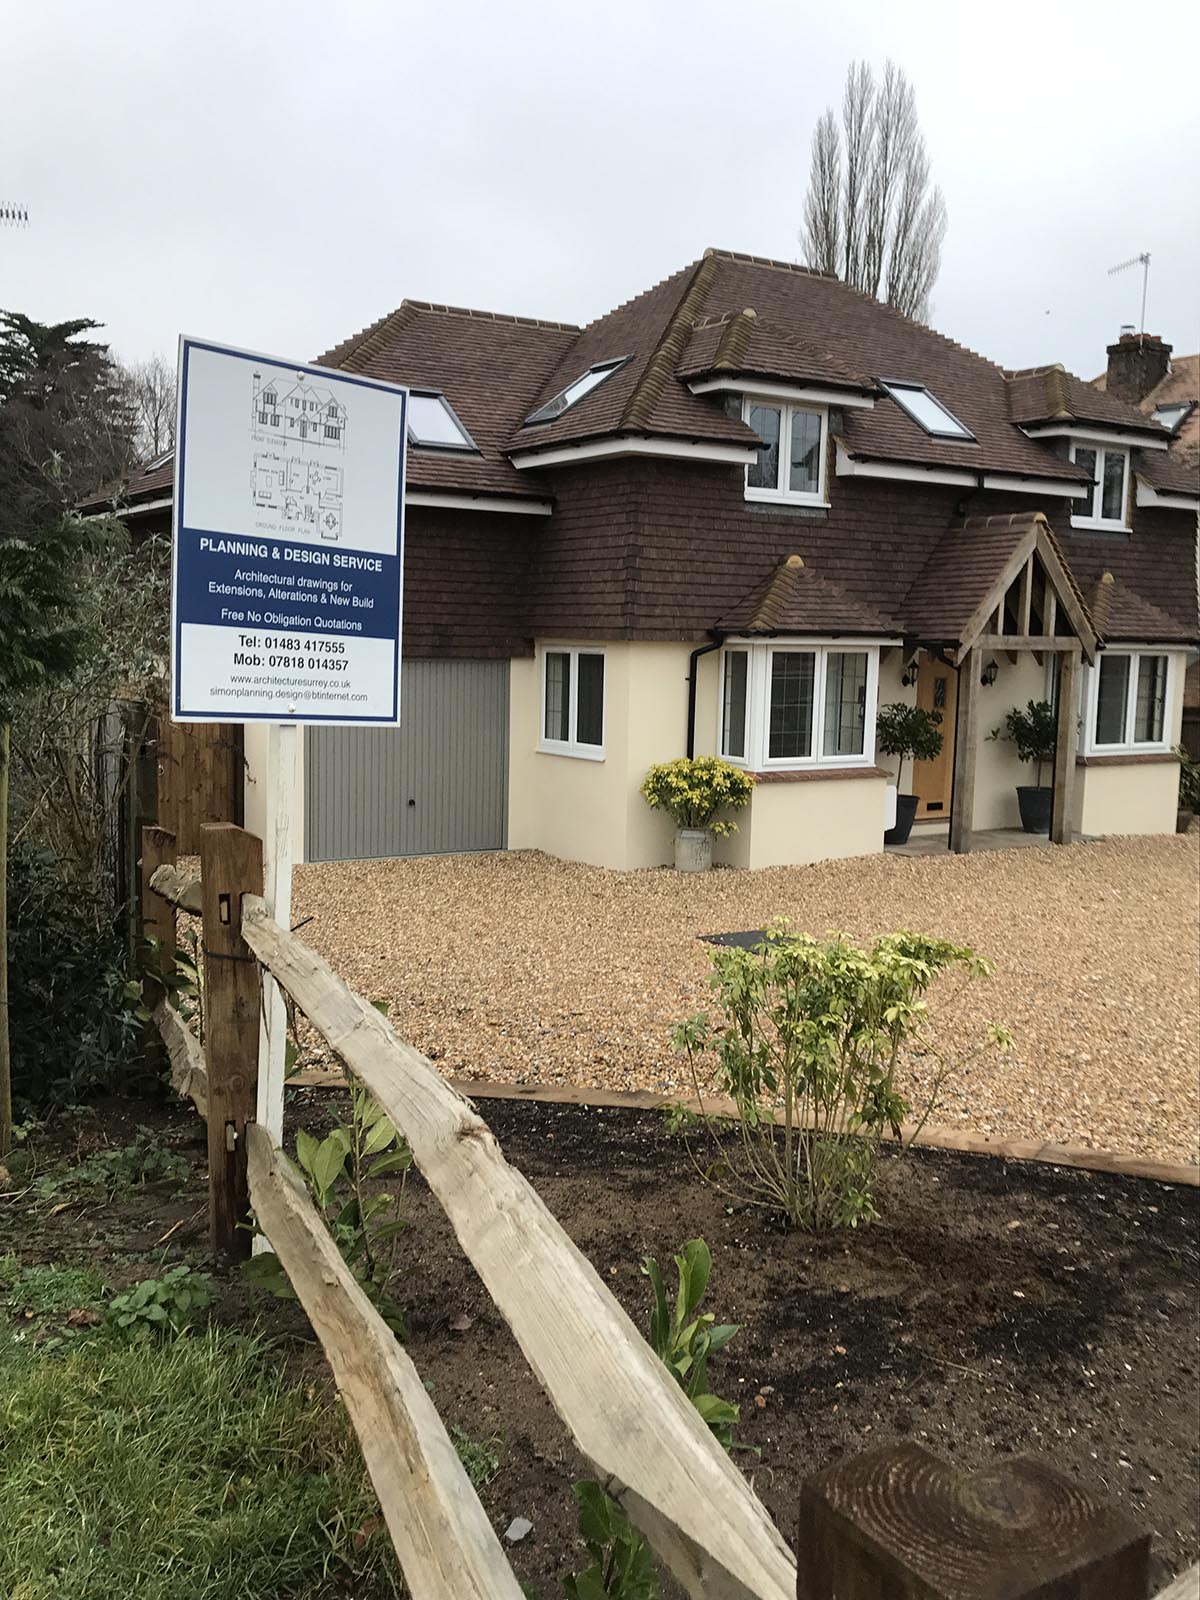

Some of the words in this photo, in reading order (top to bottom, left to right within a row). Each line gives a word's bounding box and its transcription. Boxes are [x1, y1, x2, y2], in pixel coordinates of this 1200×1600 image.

[200, 537, 268, 558] PLANNING
[272, 547, 280, 560] &
[284, 548, 330, 566] DESIGN
[333, 554, 382, 572] SERVICE
[234, 569, 295, 586] Architectural
[297, 576, 338, 592] drawings
[340, 581, 353, 592] for
[208, 581, 266, 599] Extensions,
[268, 587, 318, 603] Alterations
[320, 593, 328, 604] &
[330, 594, 350, 606] New
[352, 596, 374, 609] Build
[221, 608, 244, 621] Free
[247, 610, 261, 622] No
[264, 612, 312, 627] Obligation
[314, 616, 362, 631] Quotations
[239, 634, 261, 648] Tel:
[265, 637, 300, 651] 01483
[304, 640, 345, 654] 417555
[234, 653, 265, 666] Mob:
[269, 655, 304, 669] 07818
[308, 658, 349, 671] 014357
[230, 675, 351, 689] www.architecturesurrey.co.uk
[210, 686, 368, 701] simonplanning.design@btinternet.com
